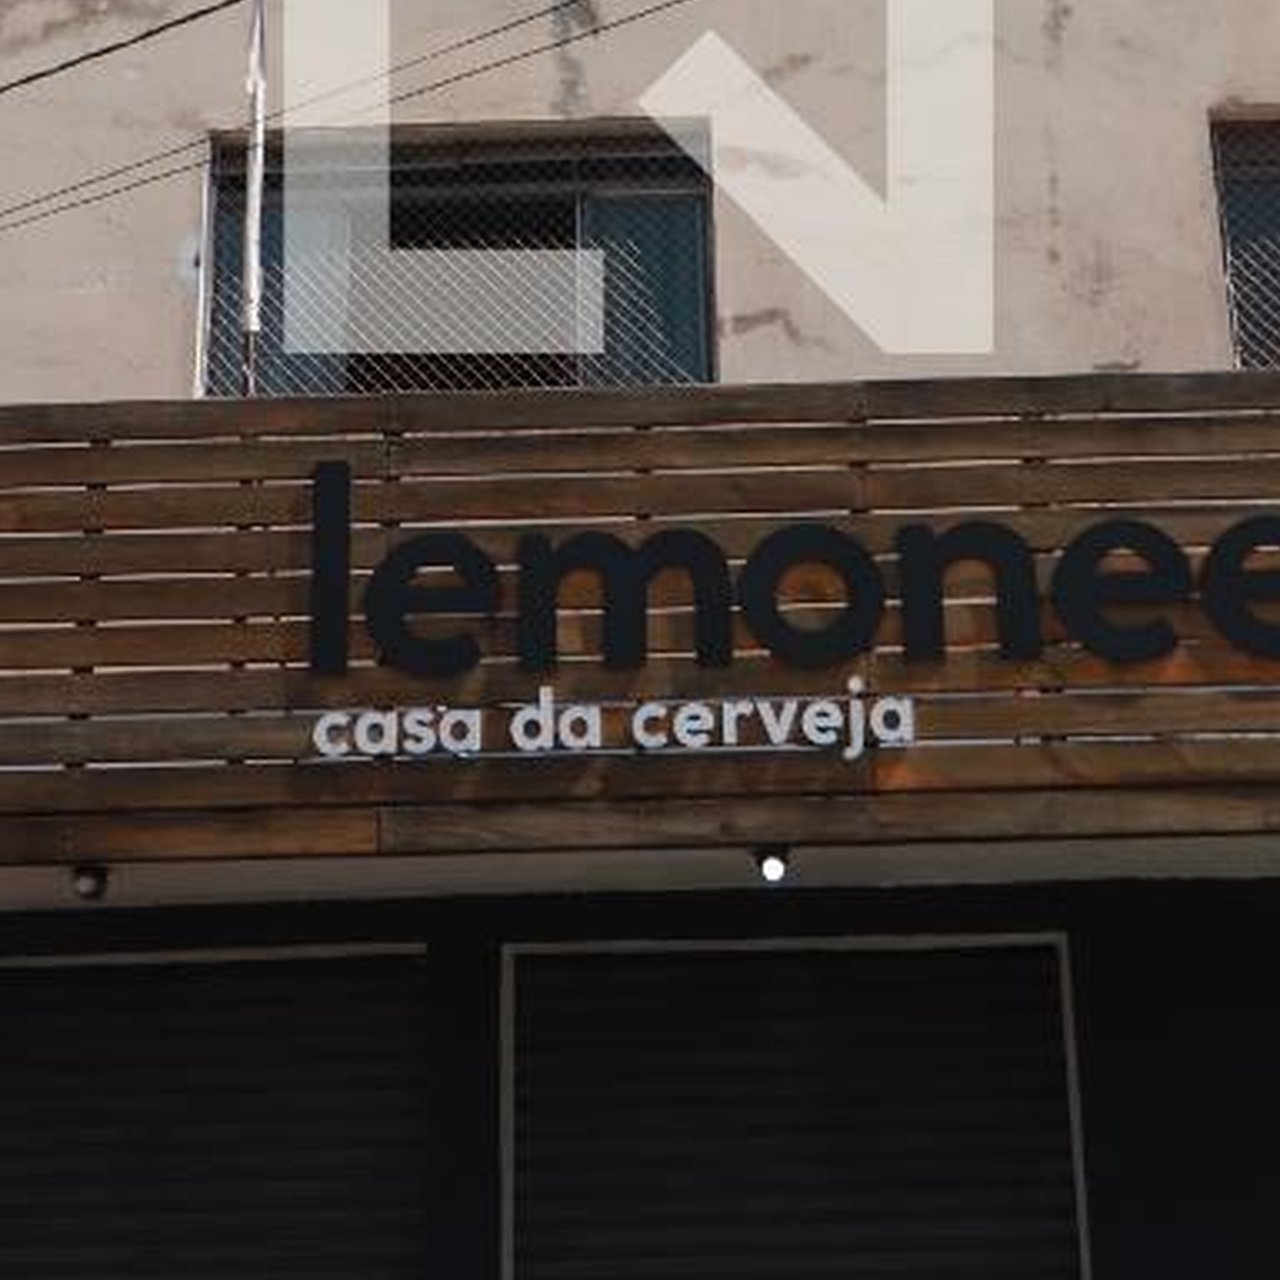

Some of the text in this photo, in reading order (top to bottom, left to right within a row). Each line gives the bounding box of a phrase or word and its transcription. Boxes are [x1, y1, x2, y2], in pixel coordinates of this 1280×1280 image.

[312, 676, 916, 760] casa da cerveja
